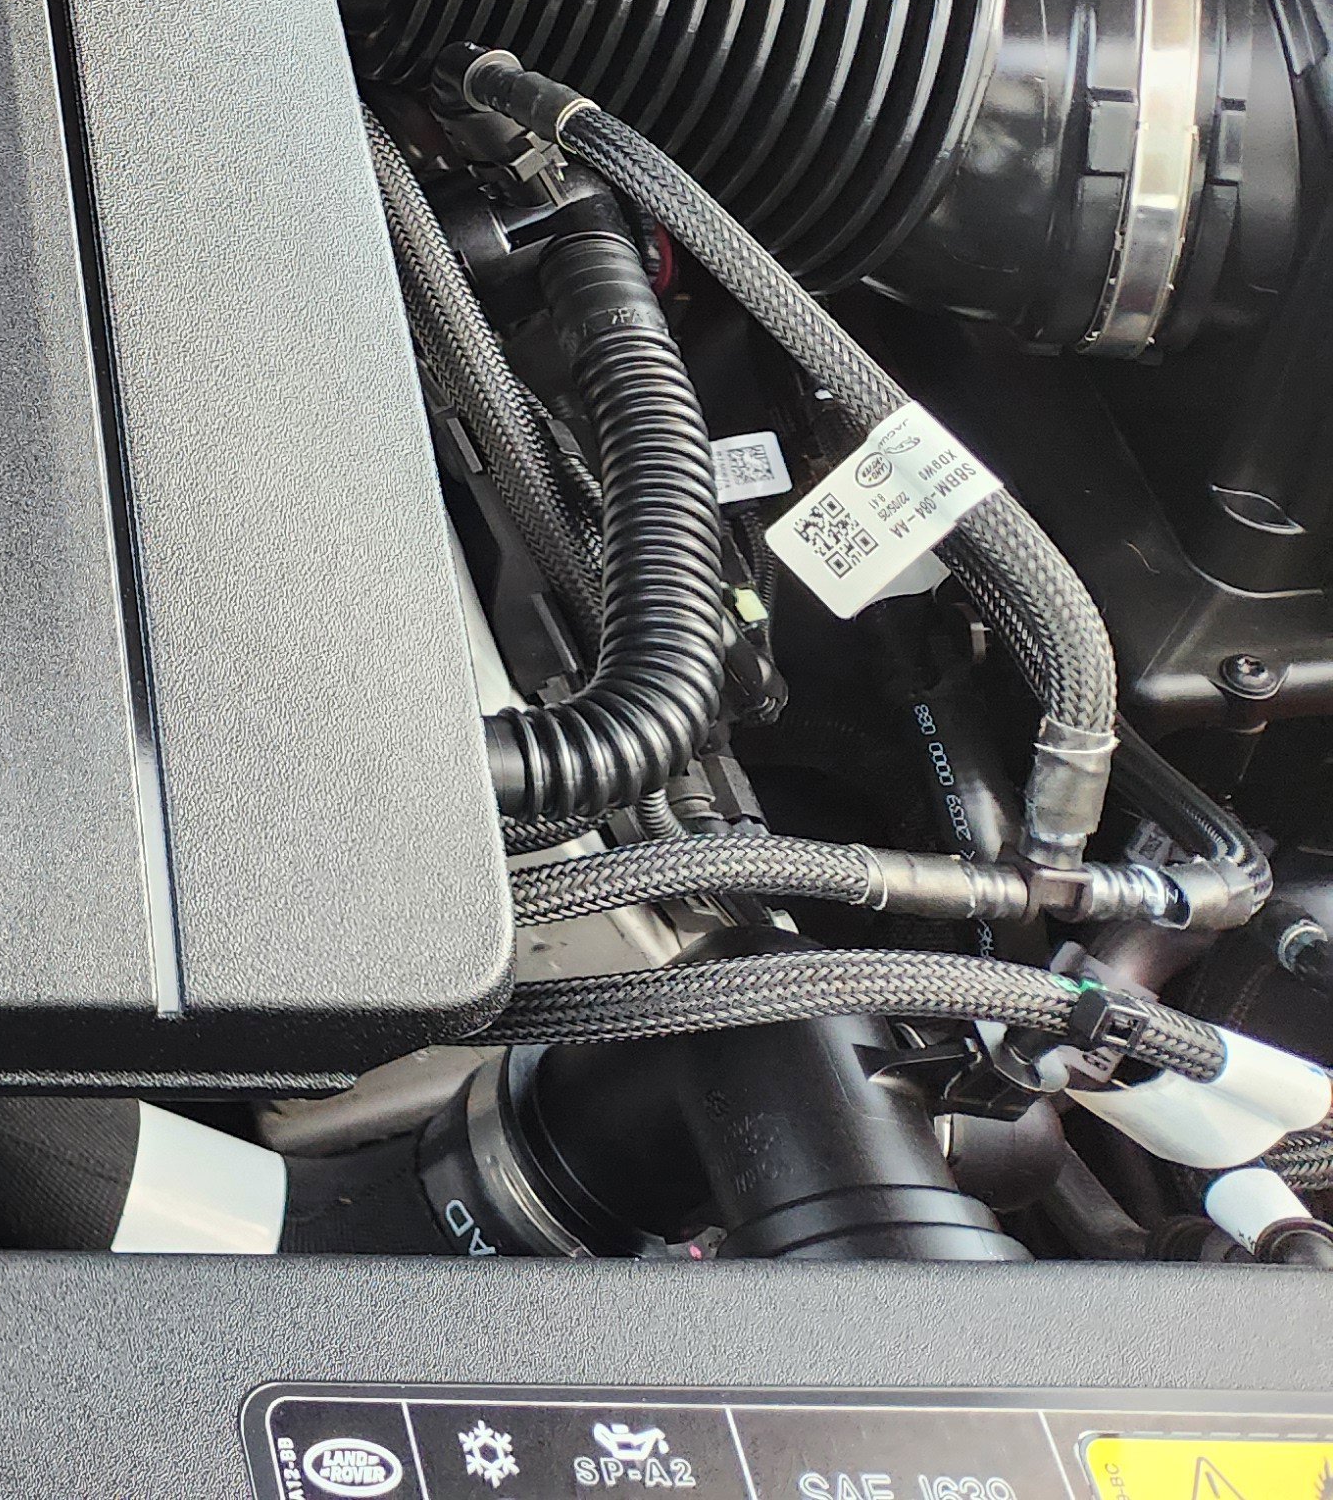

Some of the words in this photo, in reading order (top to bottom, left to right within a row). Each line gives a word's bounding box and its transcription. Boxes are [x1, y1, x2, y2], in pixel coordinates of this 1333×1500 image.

[322, 1450, 369, 1467] LAND
[329, 1465, 386, 1484] ROVER
[573, 1455, 697, 1488] SP-A2
